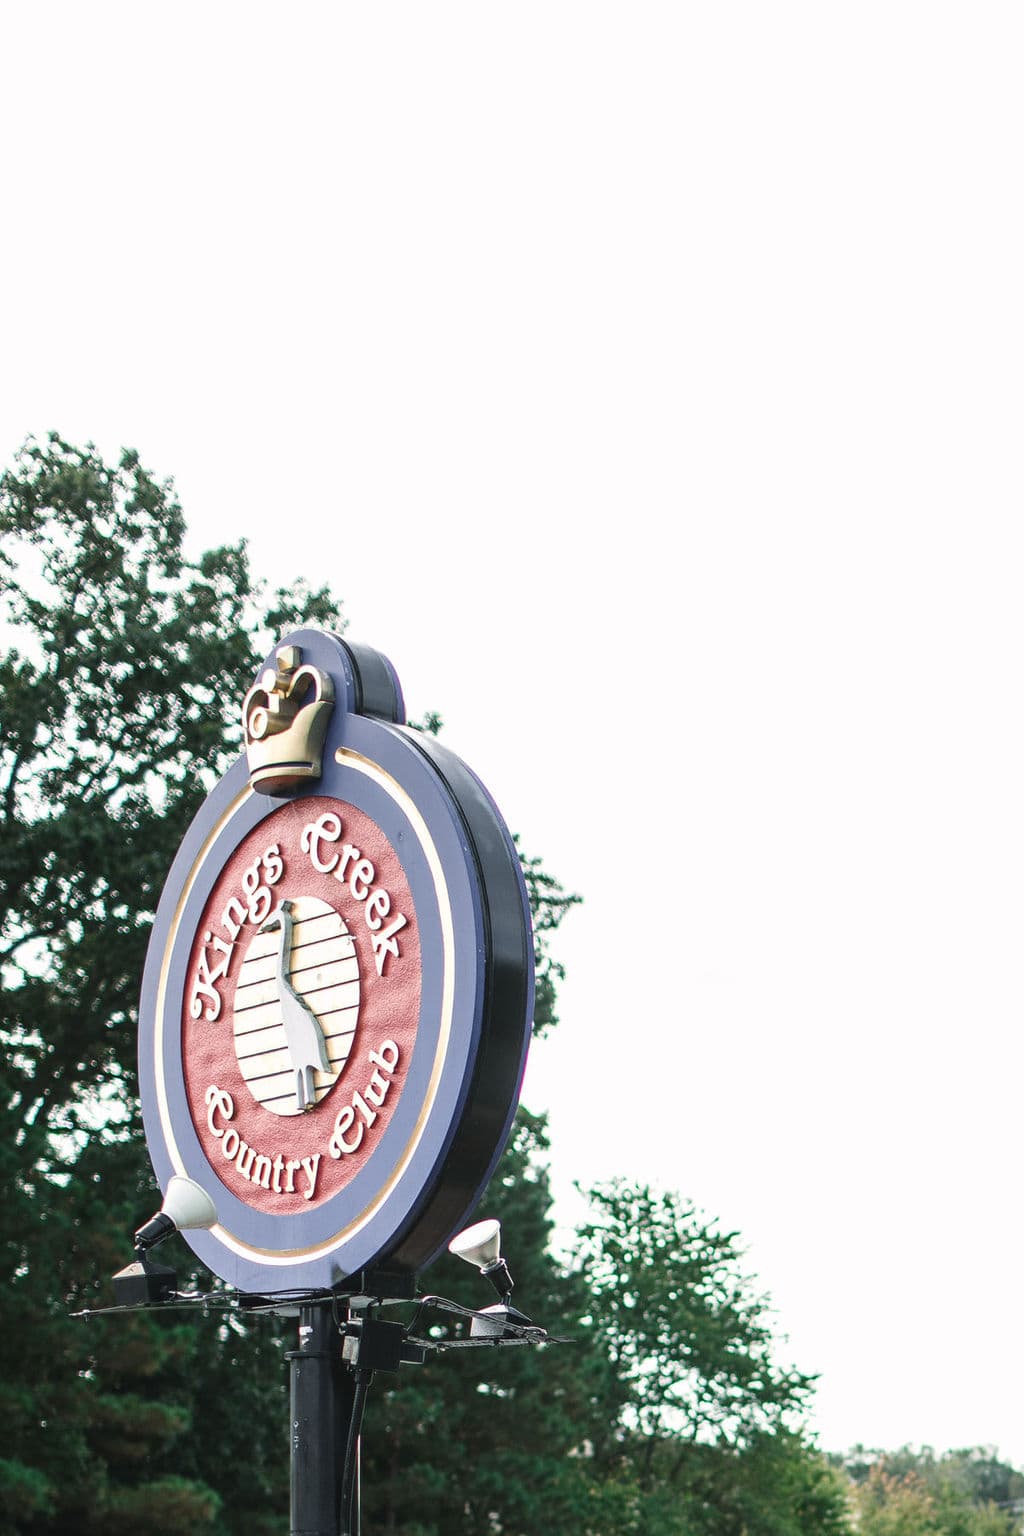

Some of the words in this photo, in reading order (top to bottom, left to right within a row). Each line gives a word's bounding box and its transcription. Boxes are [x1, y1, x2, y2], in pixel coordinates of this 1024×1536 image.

[190, 841, 284, 1023] Kings
[300, 811, 408, 976] Creek
[204, 1084, 321, 1199] Country
[328, 1038, 400, 1160] Club
